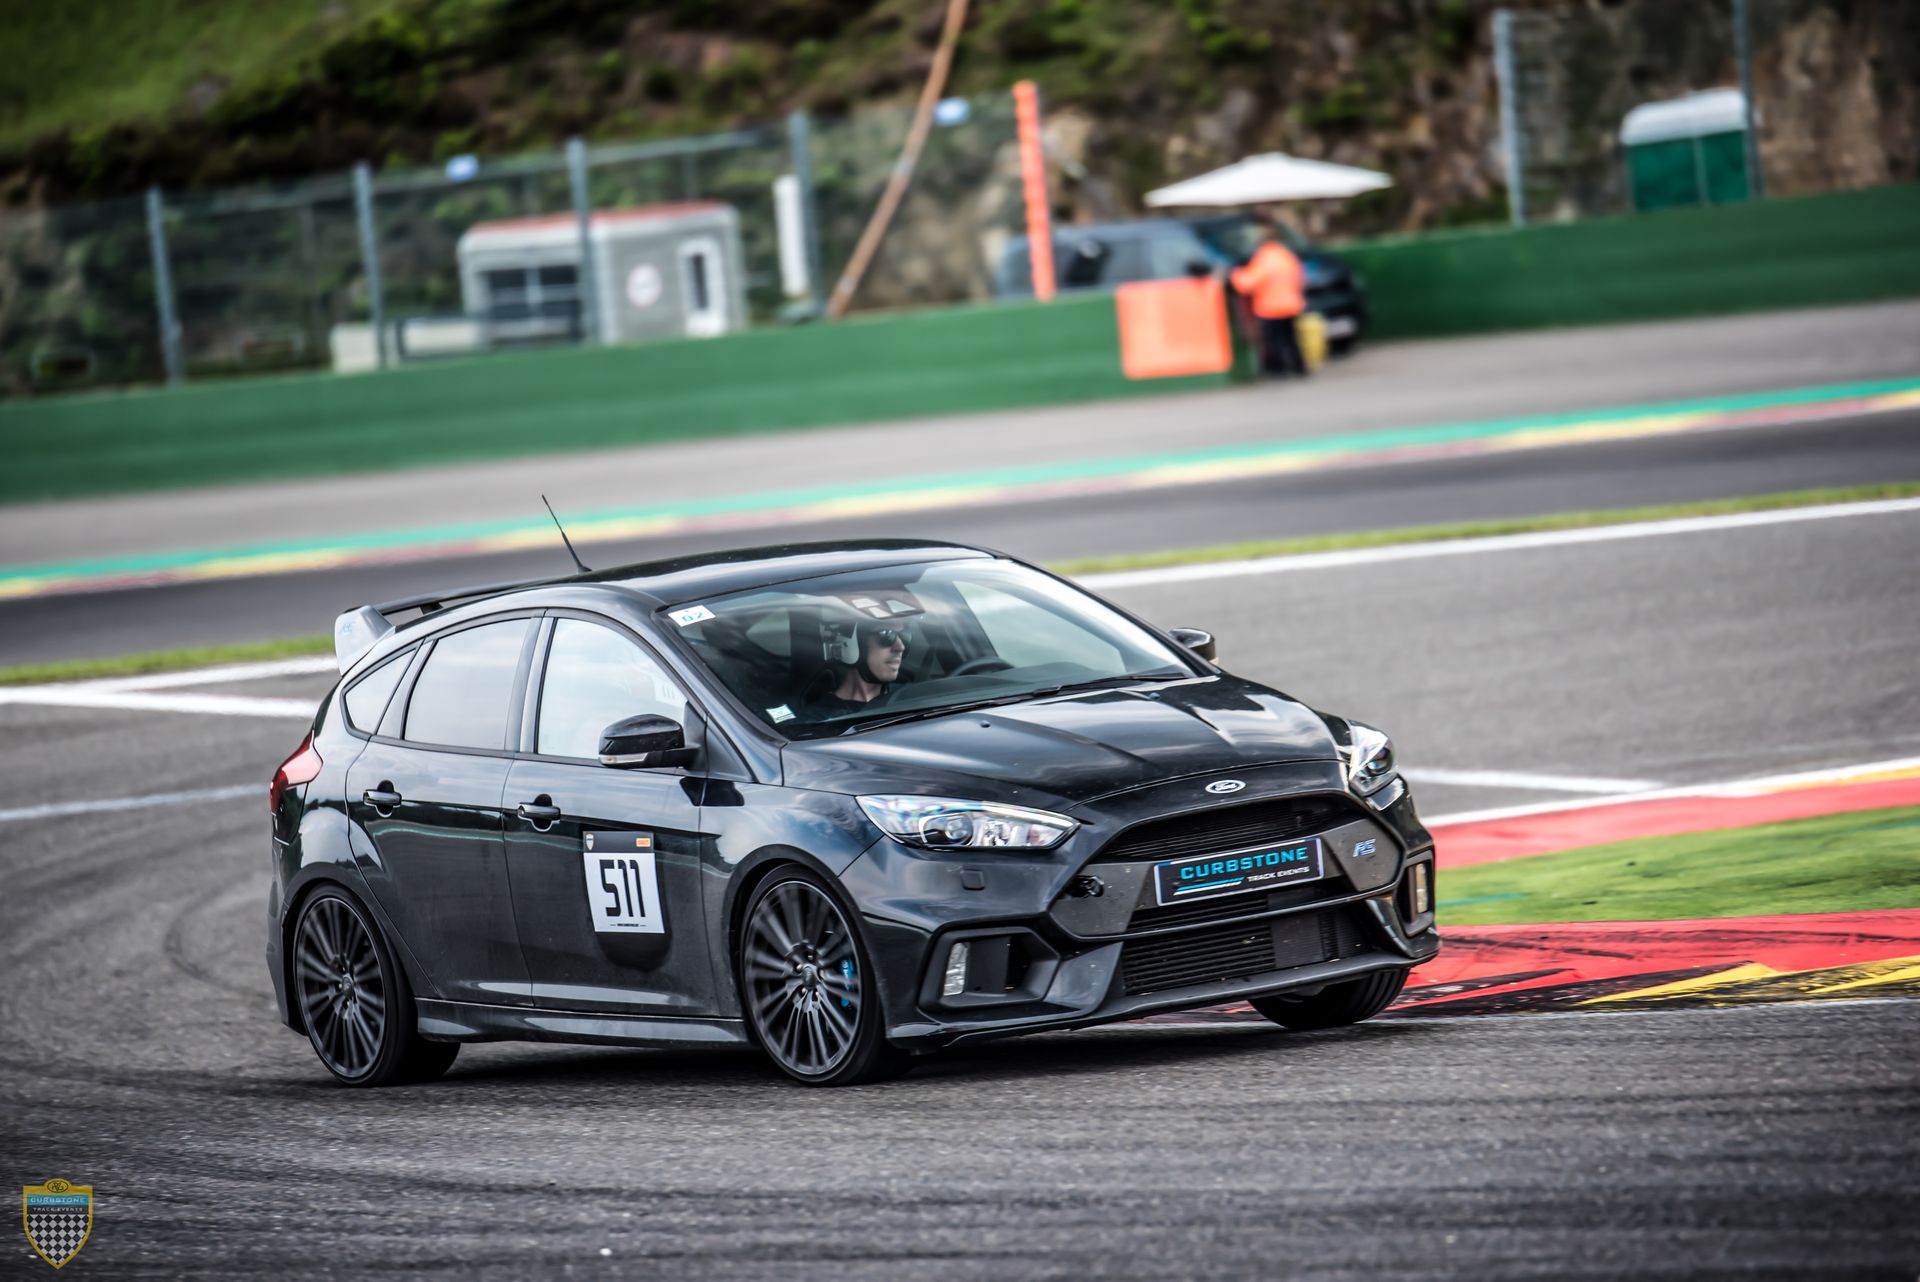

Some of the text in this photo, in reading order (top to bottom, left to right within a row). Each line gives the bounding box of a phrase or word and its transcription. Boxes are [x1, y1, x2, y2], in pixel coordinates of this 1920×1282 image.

[1180, 847, 1309, 880] CURBSTONE
[1248, 866, 1310, 882] TRACK EVENTS
[599, 859, 646, 917] 511
